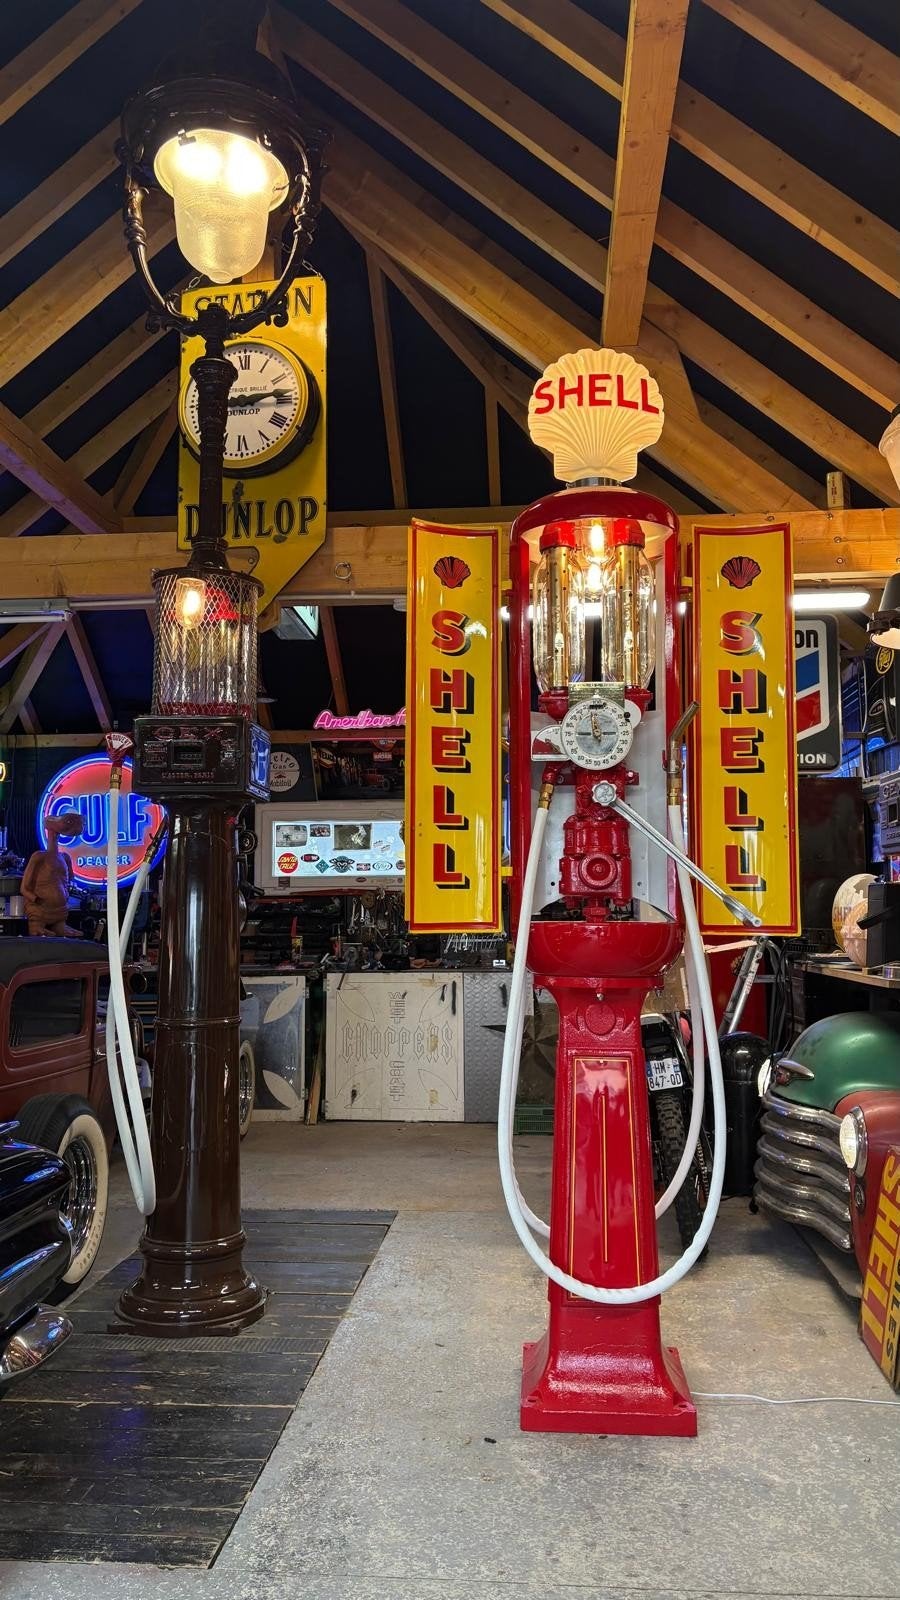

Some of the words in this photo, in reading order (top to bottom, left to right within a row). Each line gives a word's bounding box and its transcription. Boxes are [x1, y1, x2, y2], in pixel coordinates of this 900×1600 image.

[194, 285, 314, 318] STATN
[534, 375, 660, 415] SHELL
[429, 609, 475, 891] SHELL
[718, 609, 768, 892] SHELL
[796, 753, 827, 764] ION
